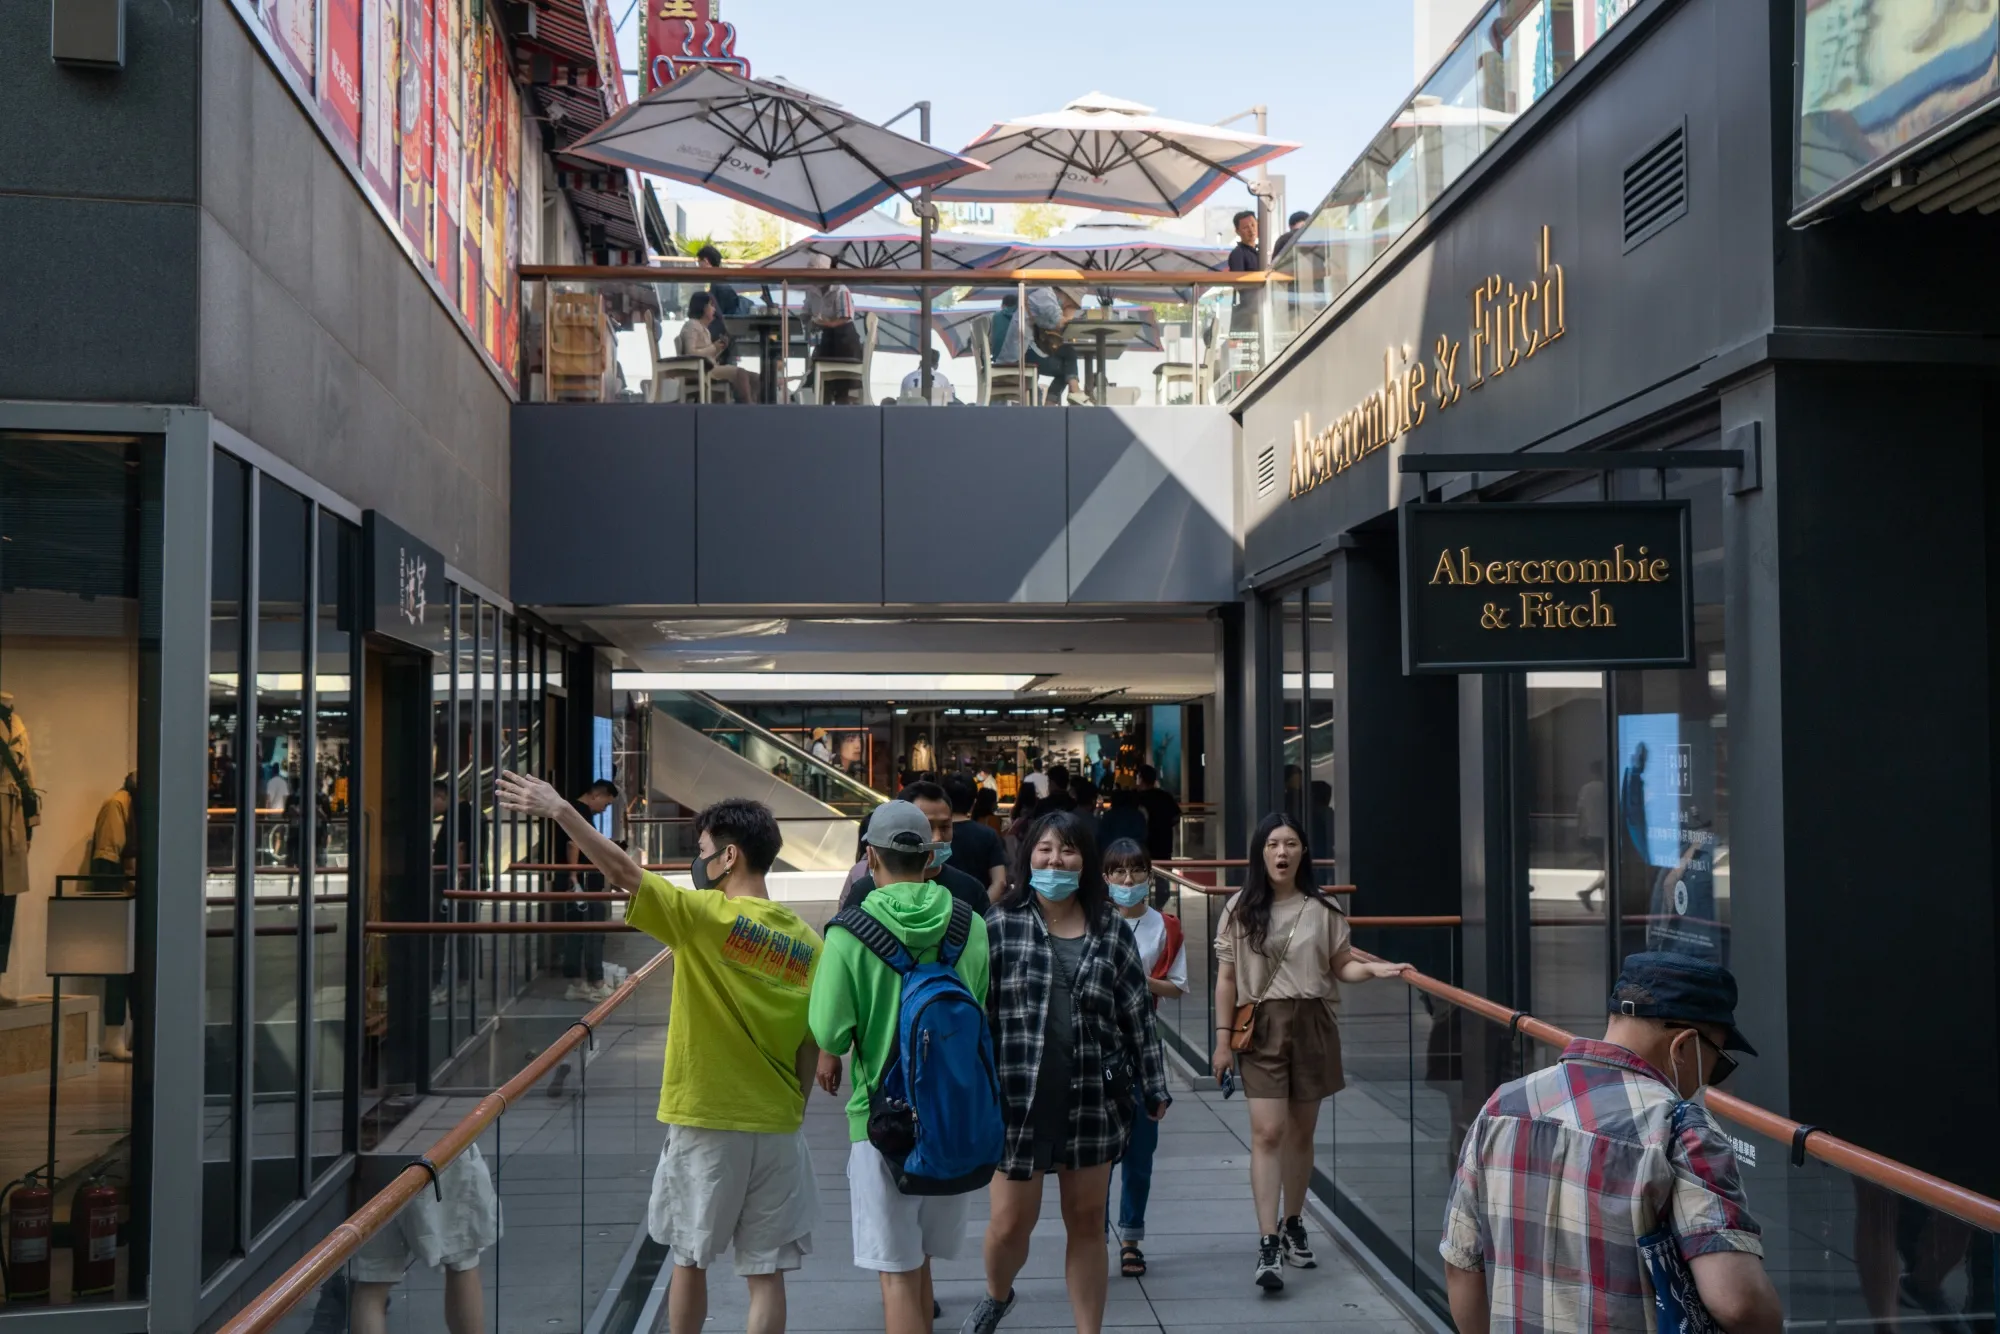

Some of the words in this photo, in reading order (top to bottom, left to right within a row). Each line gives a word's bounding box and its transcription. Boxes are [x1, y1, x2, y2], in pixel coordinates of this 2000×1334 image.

[1289, 345, 1426, 499] Abercrombie
[1432, 334, 1460, 410] &
[1467, 224, 1566, 390] Fitch
[1428, 543, 1670, 586] Abercrombie
[1480, 602, 1510, 630] &
[1519, 588, 1616, 629] Fitch
[732, 914, 771, 946] READY
[768, 931, 791, 955] FOR
[791, 938, 814, 965] MORE
